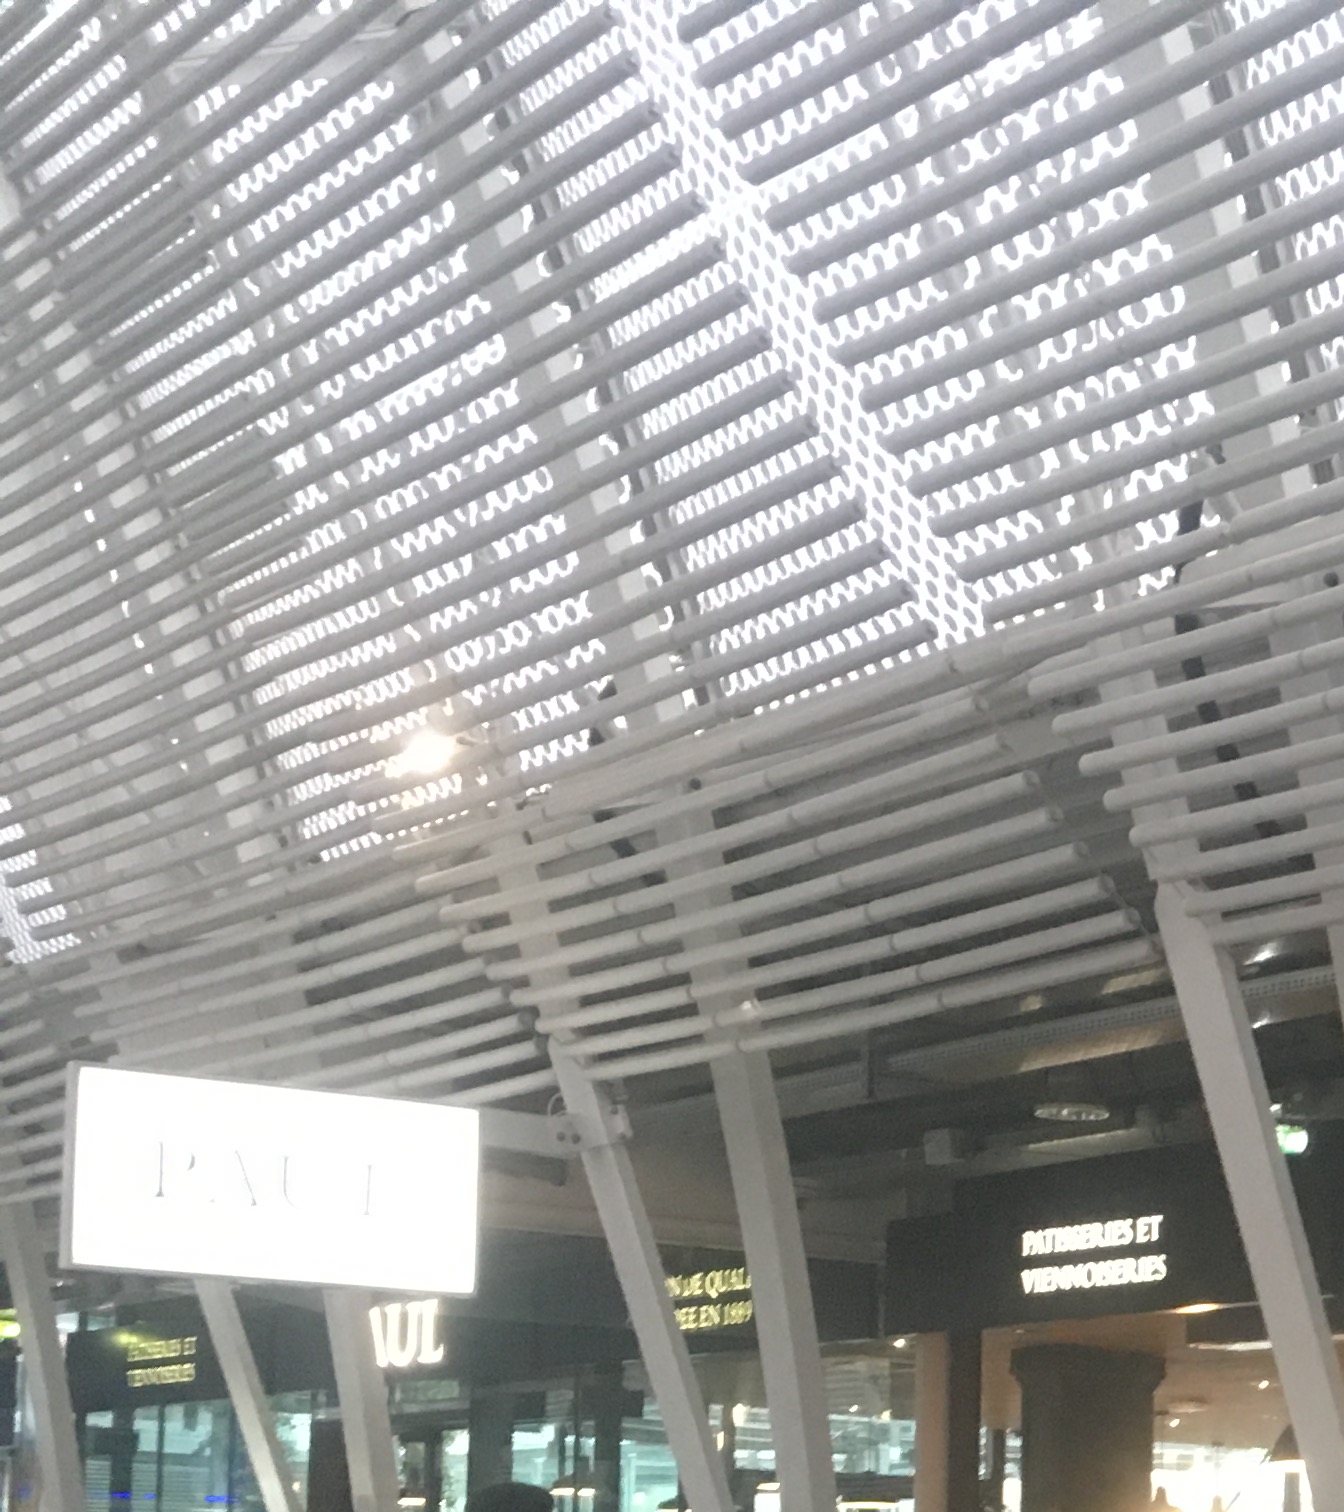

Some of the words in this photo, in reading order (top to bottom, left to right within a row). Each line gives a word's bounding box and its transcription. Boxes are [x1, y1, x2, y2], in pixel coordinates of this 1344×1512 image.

[1135, 1214, 1164, 1243] ET
[1020, 1253, 1168, 1294] VIENNOISERIES
[368, 1298, 445, 1368] AUL
